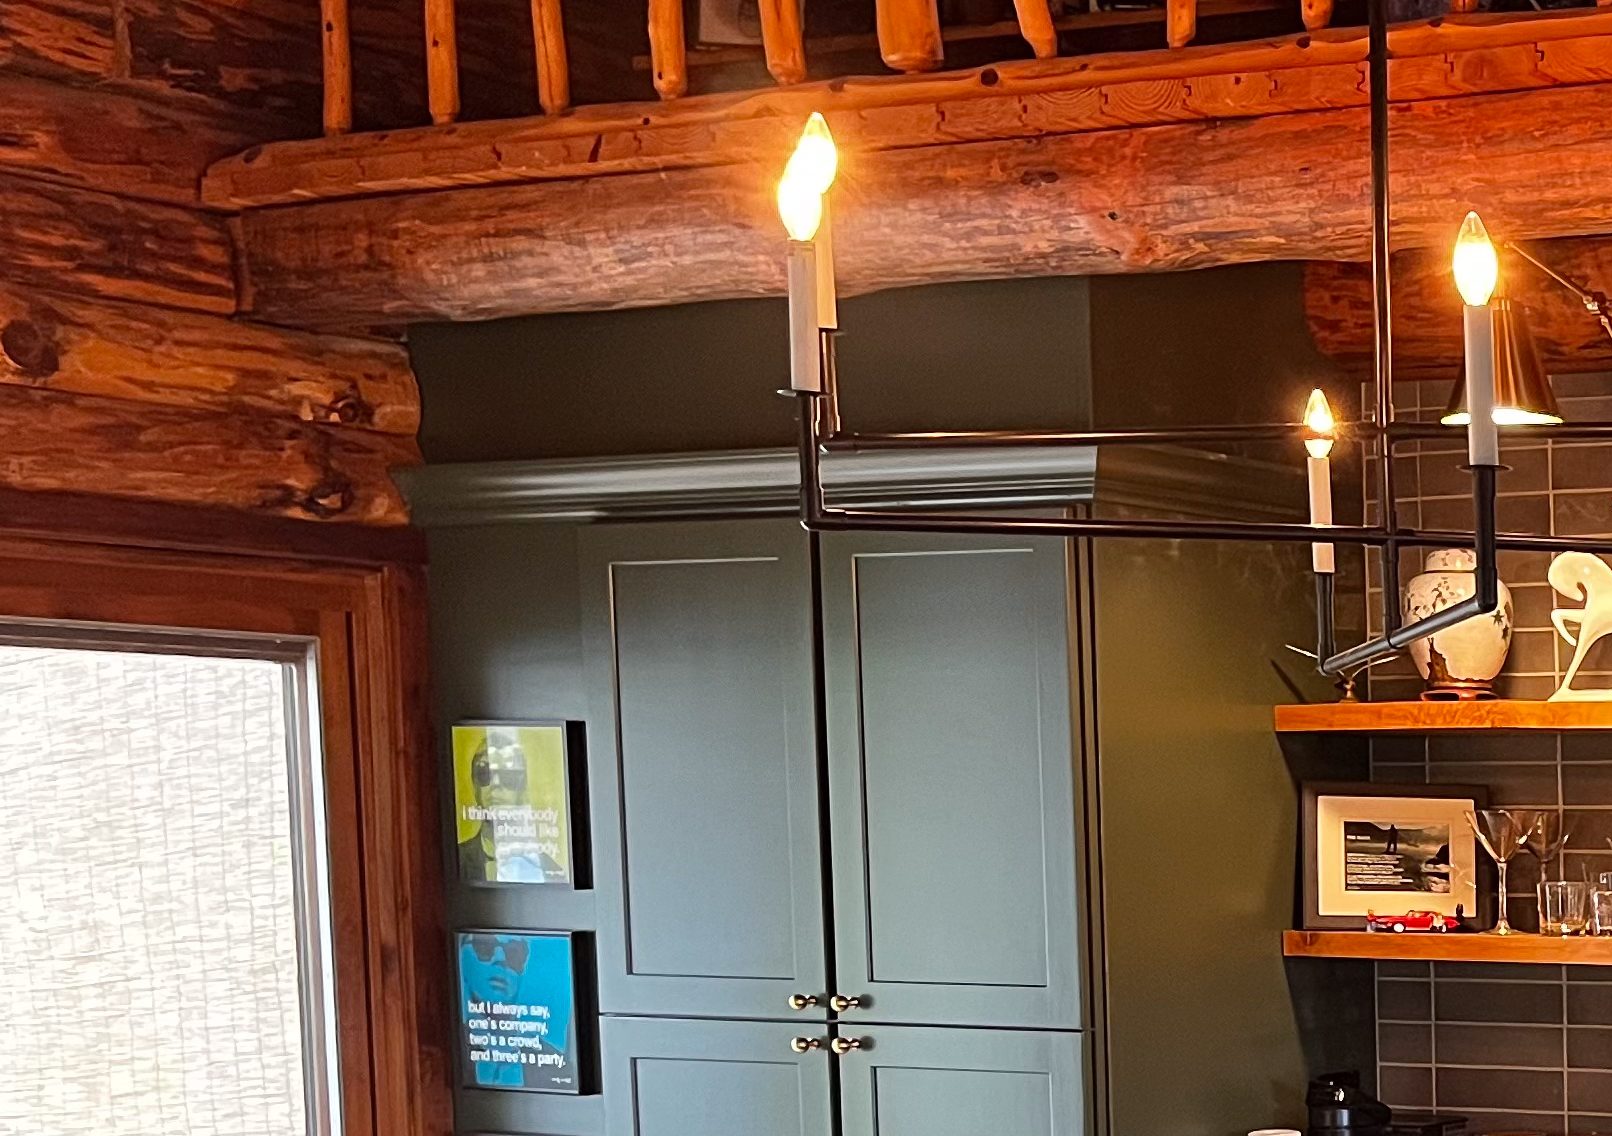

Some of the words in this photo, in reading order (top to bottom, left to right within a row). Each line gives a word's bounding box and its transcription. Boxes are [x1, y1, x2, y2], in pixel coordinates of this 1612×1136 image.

[467, 805, 497, 820] think
[497, 822, 537, 837] should
[468, 1000, 485, 1014] but
[492, 1002, 529, 1018] always
[530, 1005, 550, 1020] say,
[468, 1017, 497, 1030] one's
[469, 1032, 497, 1046] two's
[498, 1036, 506, 1046] a
[470, 1049, 490, 1062] and
[491, 1049, 527, 1063] three's
[528, 1053, 536, 1064] a
[537, 1053, 566, 1068] party.
